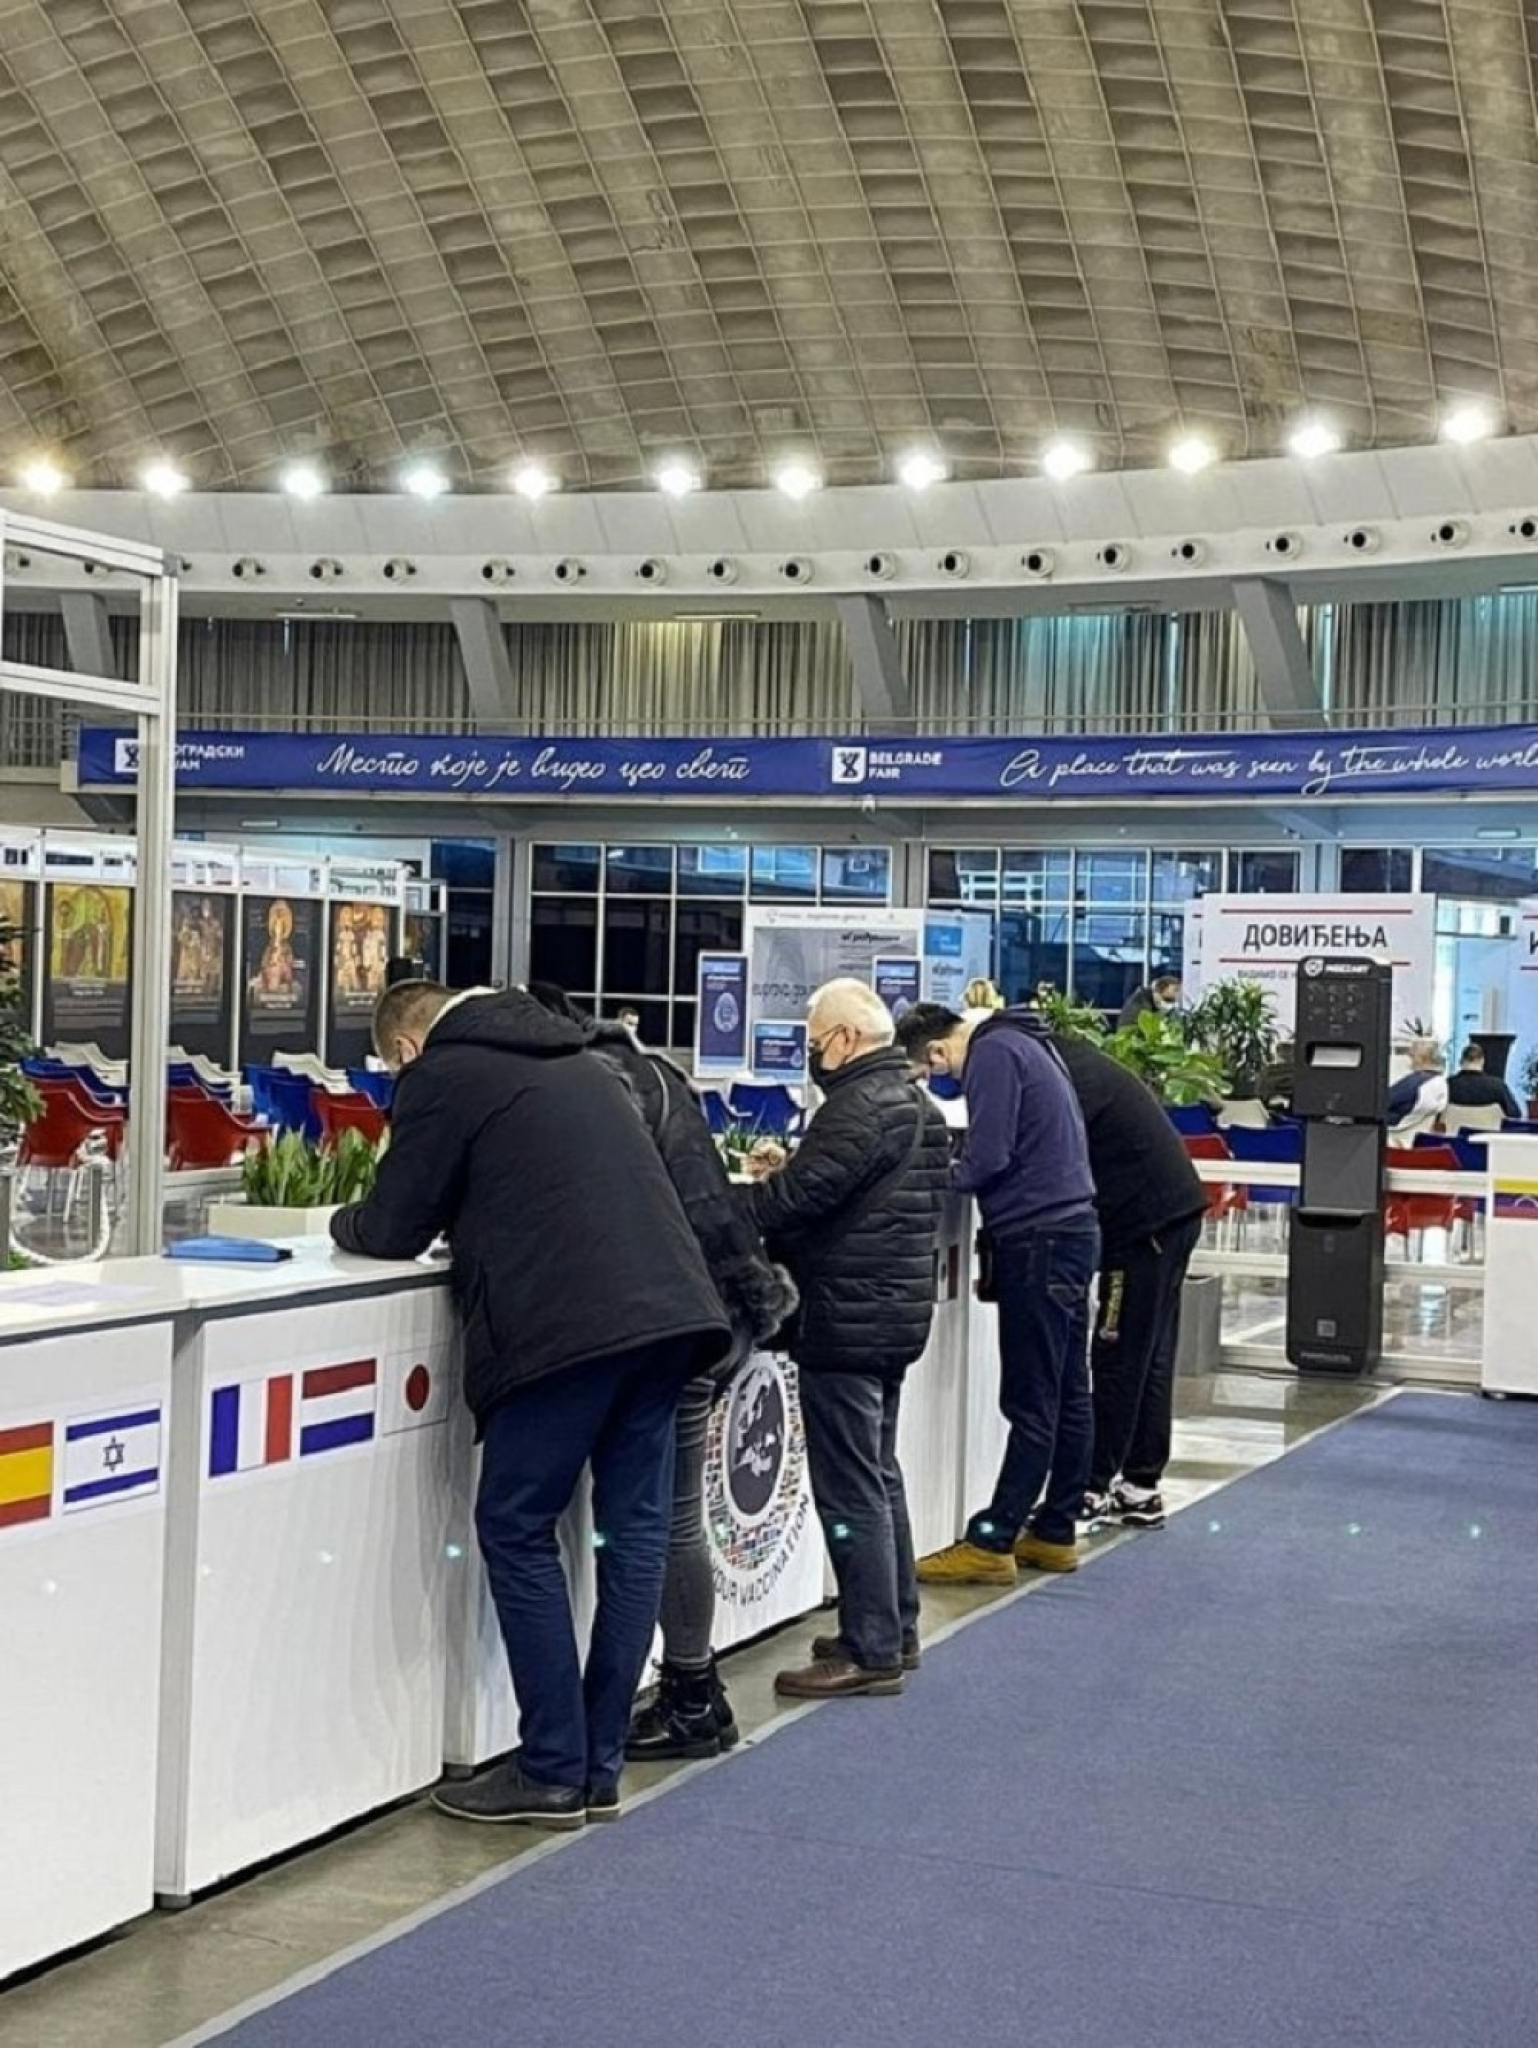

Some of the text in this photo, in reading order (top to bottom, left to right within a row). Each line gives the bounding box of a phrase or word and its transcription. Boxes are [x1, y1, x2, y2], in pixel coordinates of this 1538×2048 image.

[174, 744, 246, 759] ОГРАДСКИ
[868, 751, 943, 765] BELGRADE
[316, 742, 751, 791] Место које је видео цео свет
[868, 766, 901, 779] FAIR
[1048, 753, 1120, 787] place
[1122, 748, 1217, 776] that
[1190, 760, 1241, 779] was
[1246, 759, 1299, 779] seen
[1301, 748, 1334, 795] by
[1340, 745, 1396, 773] the
[1393, 745, 1469, 772] whole
[1475, 742, 1538, 770] worl
[1242, 923, 1388, 953] ДОВИЂЕЊА
